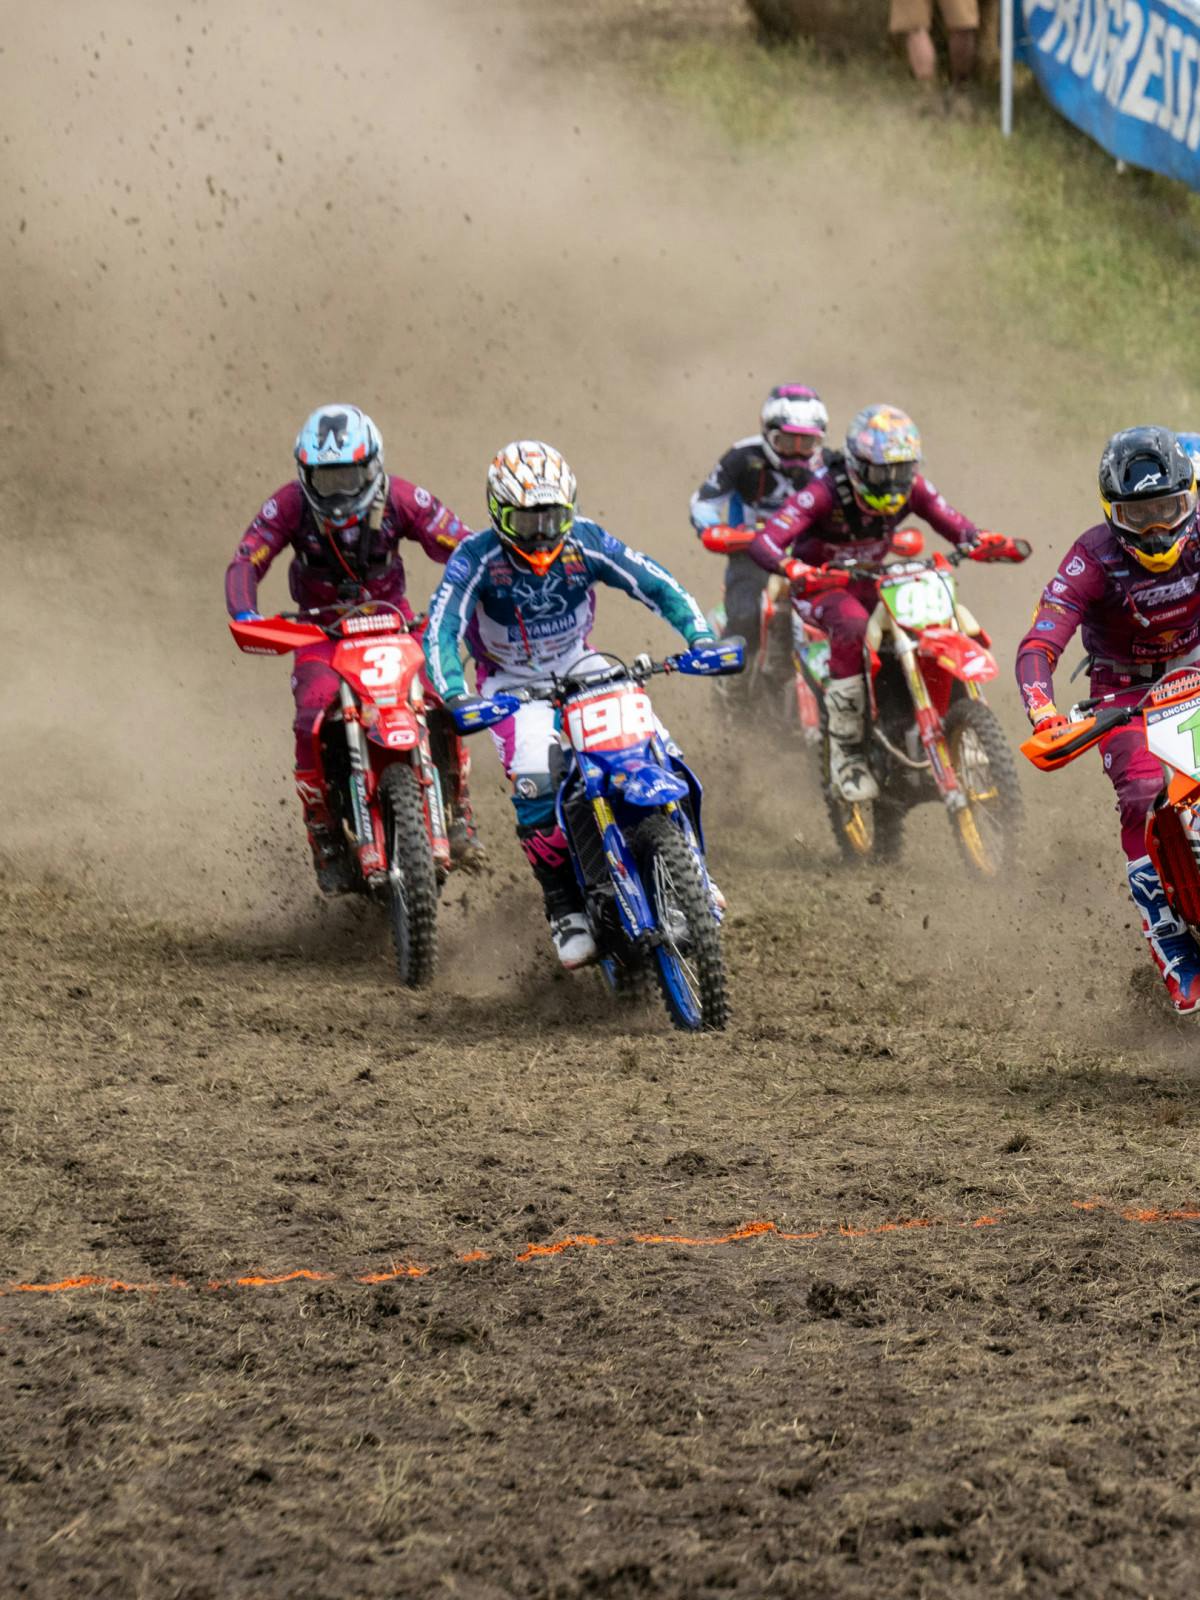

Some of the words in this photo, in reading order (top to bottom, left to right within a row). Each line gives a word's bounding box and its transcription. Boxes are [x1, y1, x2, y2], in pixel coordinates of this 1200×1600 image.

[526, 614, 577, 637] YAMAHA
[359, 645, 402, 687] 3
[567, 693, 654, 752] 198
